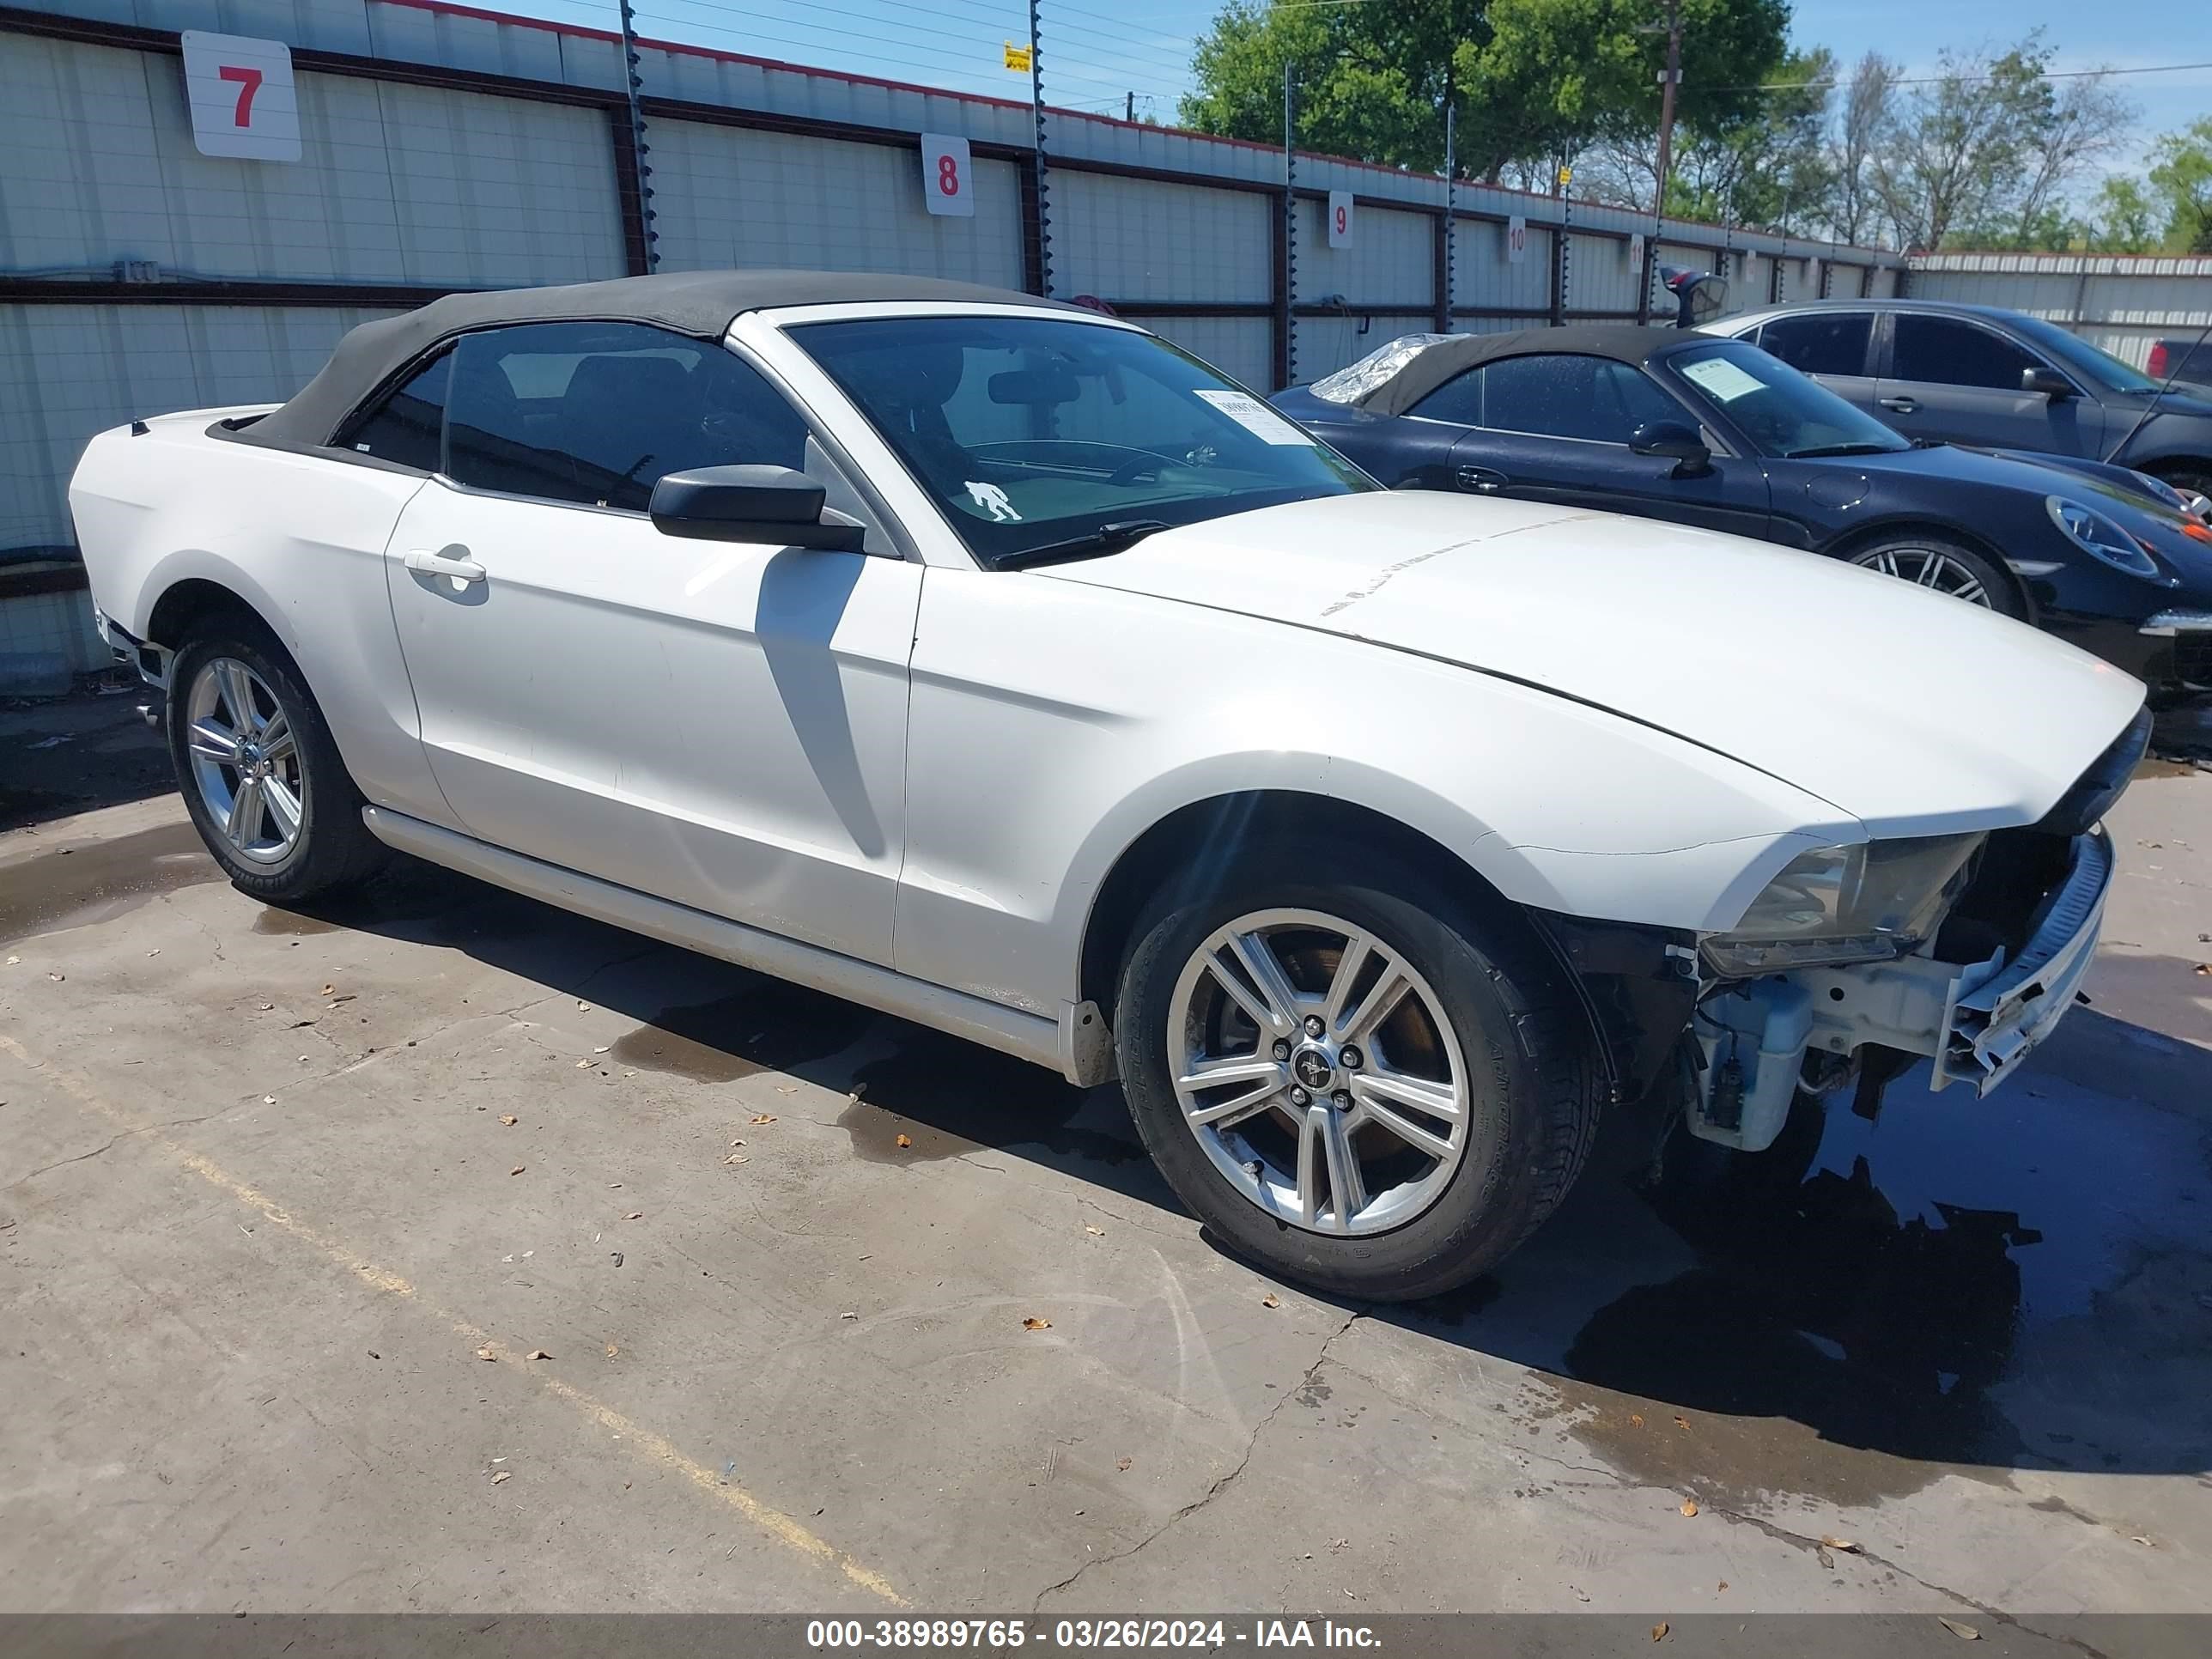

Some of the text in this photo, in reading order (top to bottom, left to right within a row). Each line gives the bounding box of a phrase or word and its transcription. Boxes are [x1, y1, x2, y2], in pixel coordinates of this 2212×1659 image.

[219, 66, 263, 128] 7
[939, 155, 959, 197] 8
[1336, 206, 1346, 234] 9
[1510, 227, 1525, 252] 10
[1632, 242, 1644, 264] 11
